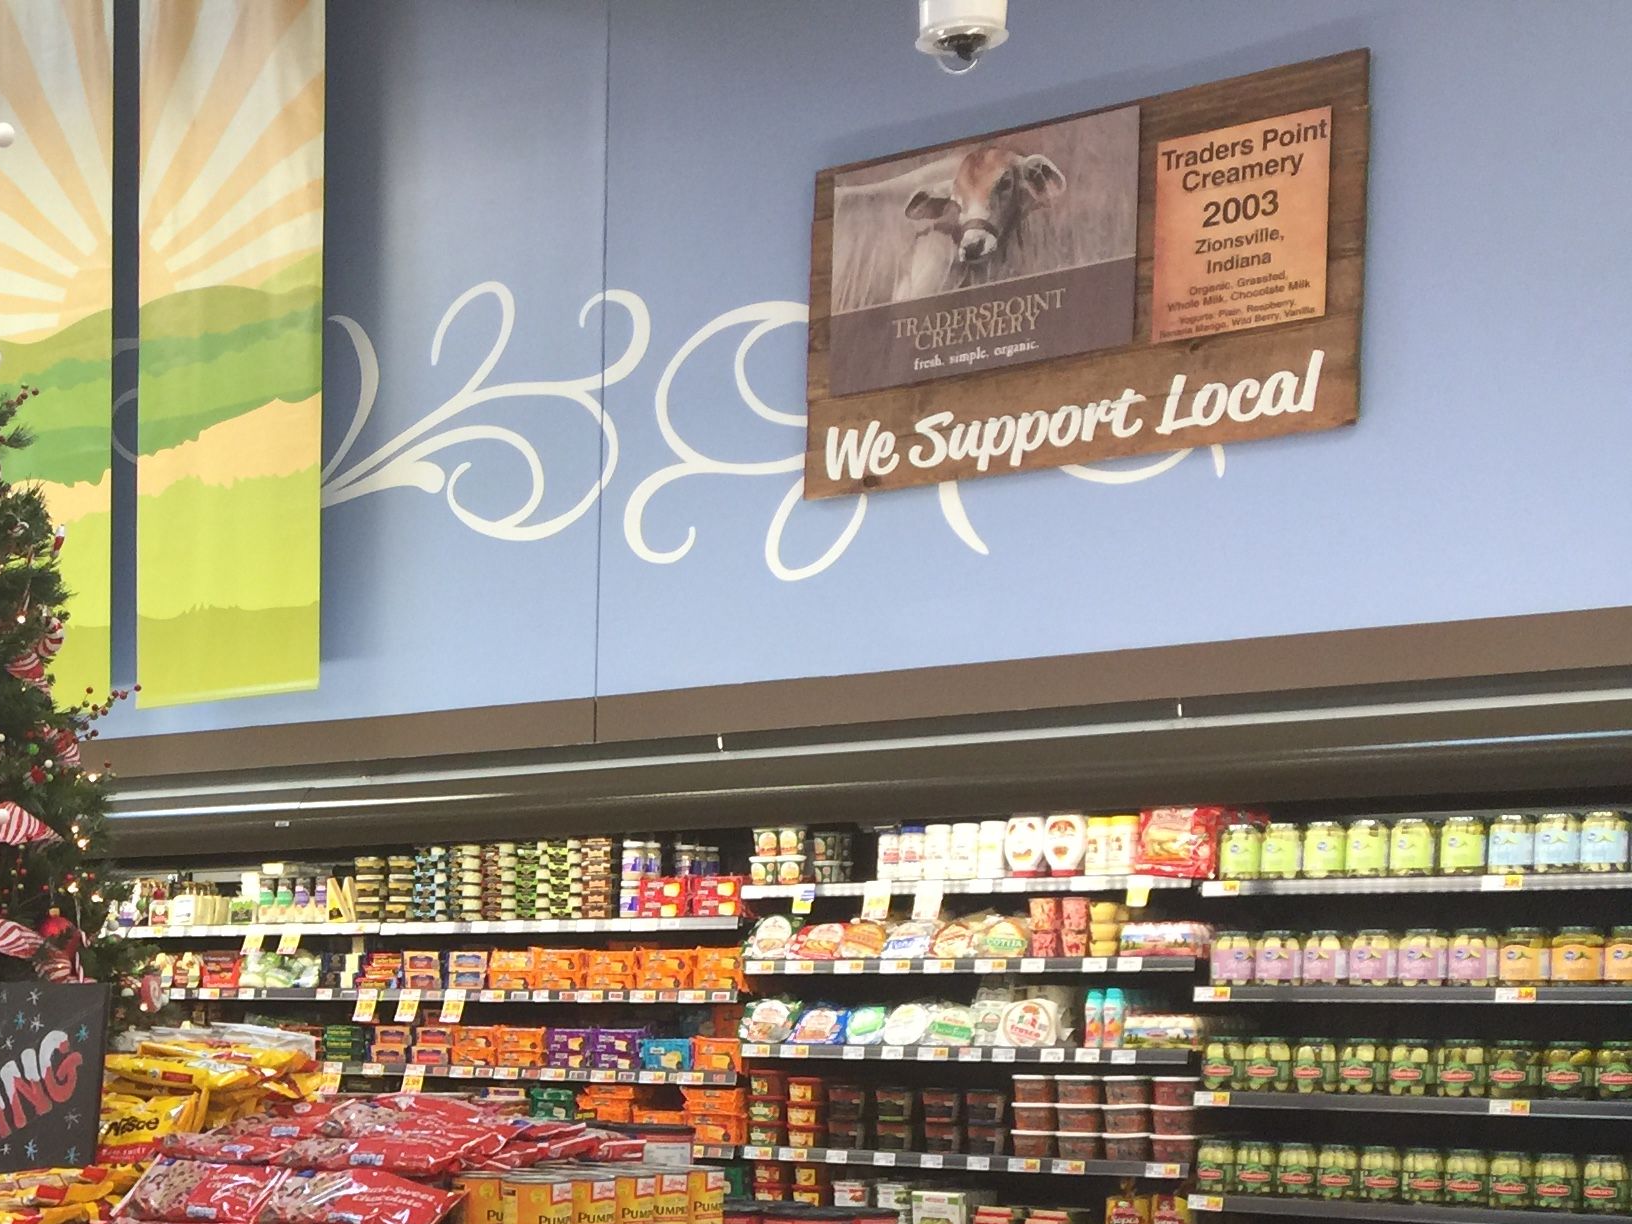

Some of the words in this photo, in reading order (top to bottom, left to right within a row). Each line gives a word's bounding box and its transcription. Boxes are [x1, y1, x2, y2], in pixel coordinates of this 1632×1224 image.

[1162, 138, 1254, 171] Traders
[1262, 119, 1327, 151] Point
[1182, 152, 1304, 193] Creamery
[1202, 189, 1279, 228] 2003
[1195, 226, 1284, 255] Zionsville,
[1207, 251, 1271, 274] Indiana
[892, 288, 1066, 338] TRADERSPOINT
[915, 309, 1040, 350] CREAMERY
[825, 419, 900, 483] We
[908, 386, 1148, 472] Support
[1155, 348, 1327, 437] Local
